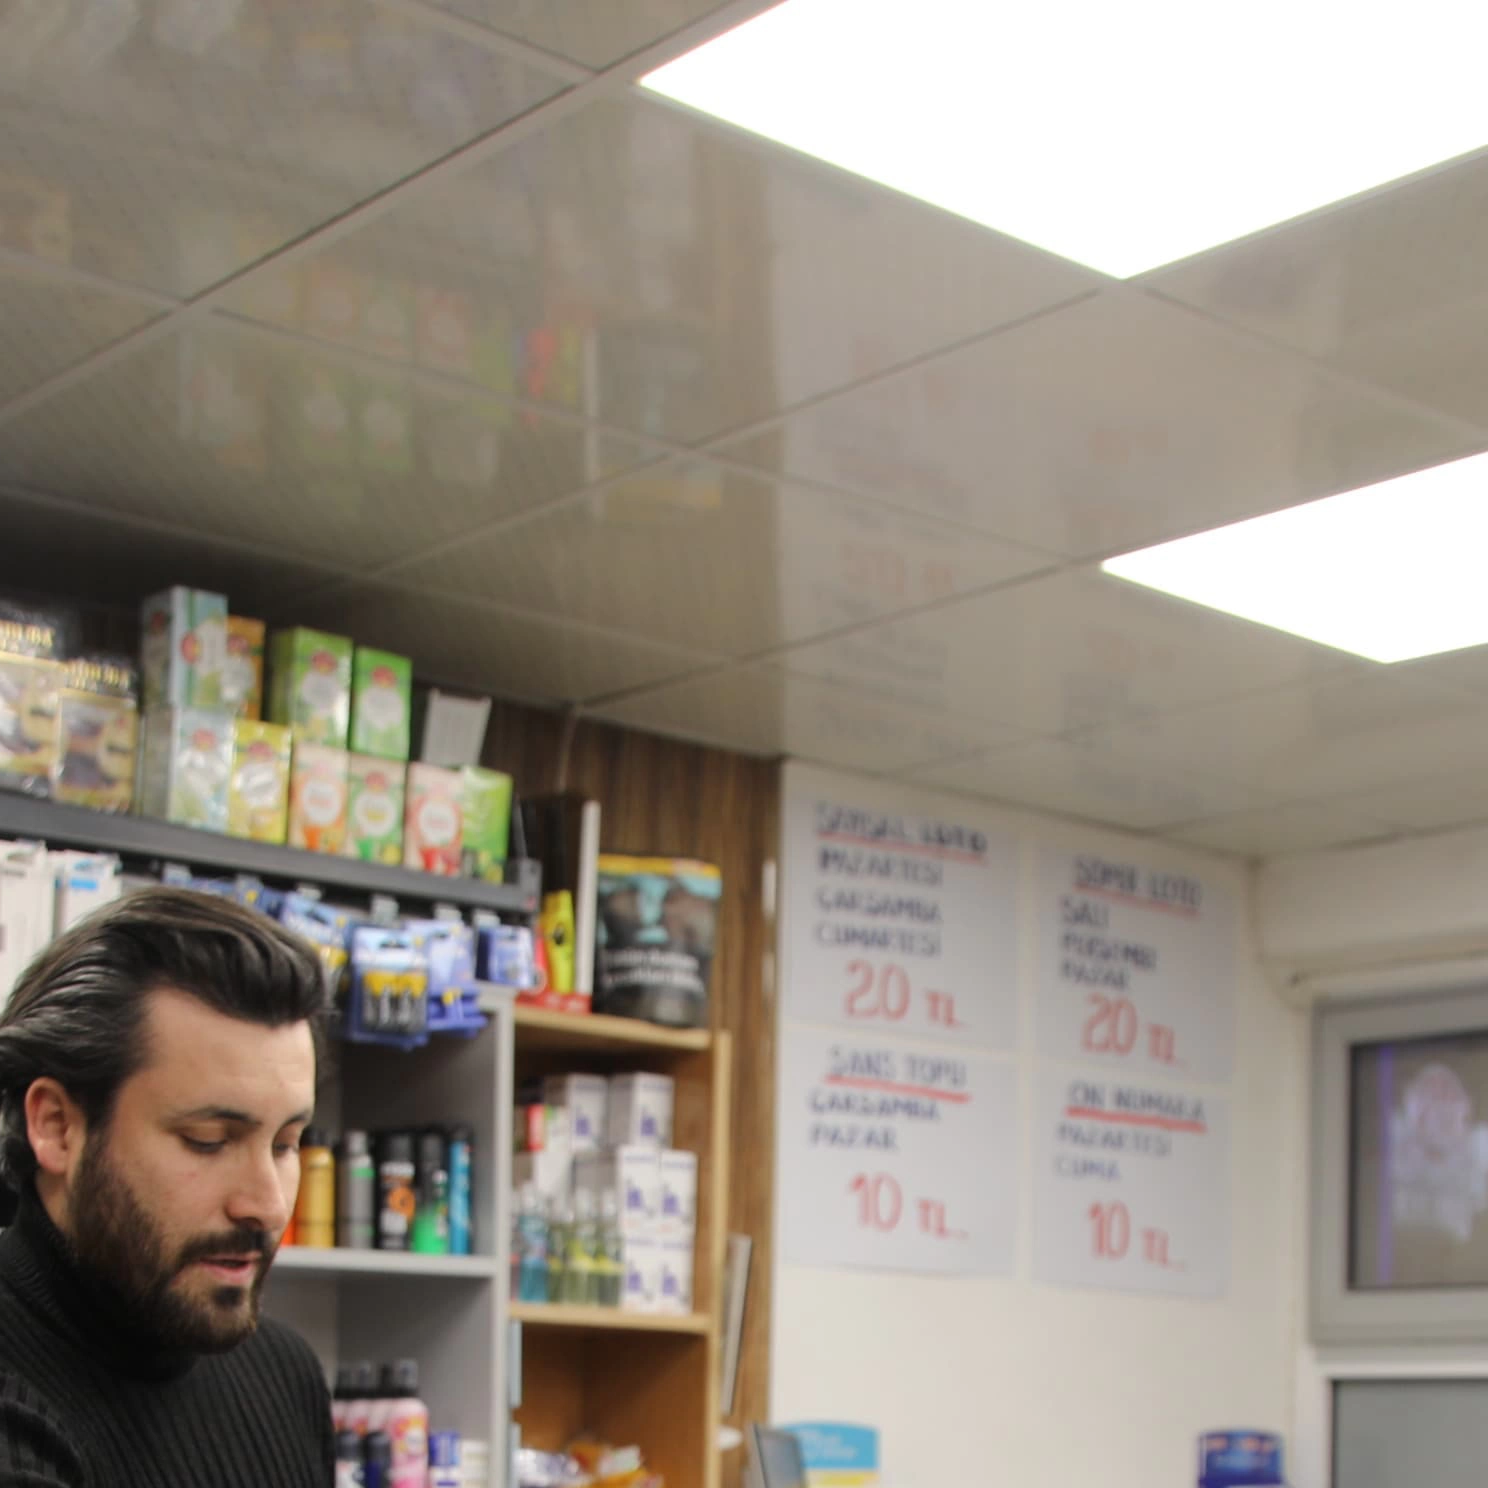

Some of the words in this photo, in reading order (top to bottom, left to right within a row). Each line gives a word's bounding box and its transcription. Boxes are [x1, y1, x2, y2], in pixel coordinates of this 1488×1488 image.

[843, 958, 911, 1021] 20
[1081, 992, 1138, 1056] 20
[848, 1171, 905, 1233] 10
[1087, 1200, 1131, 1261] 10
